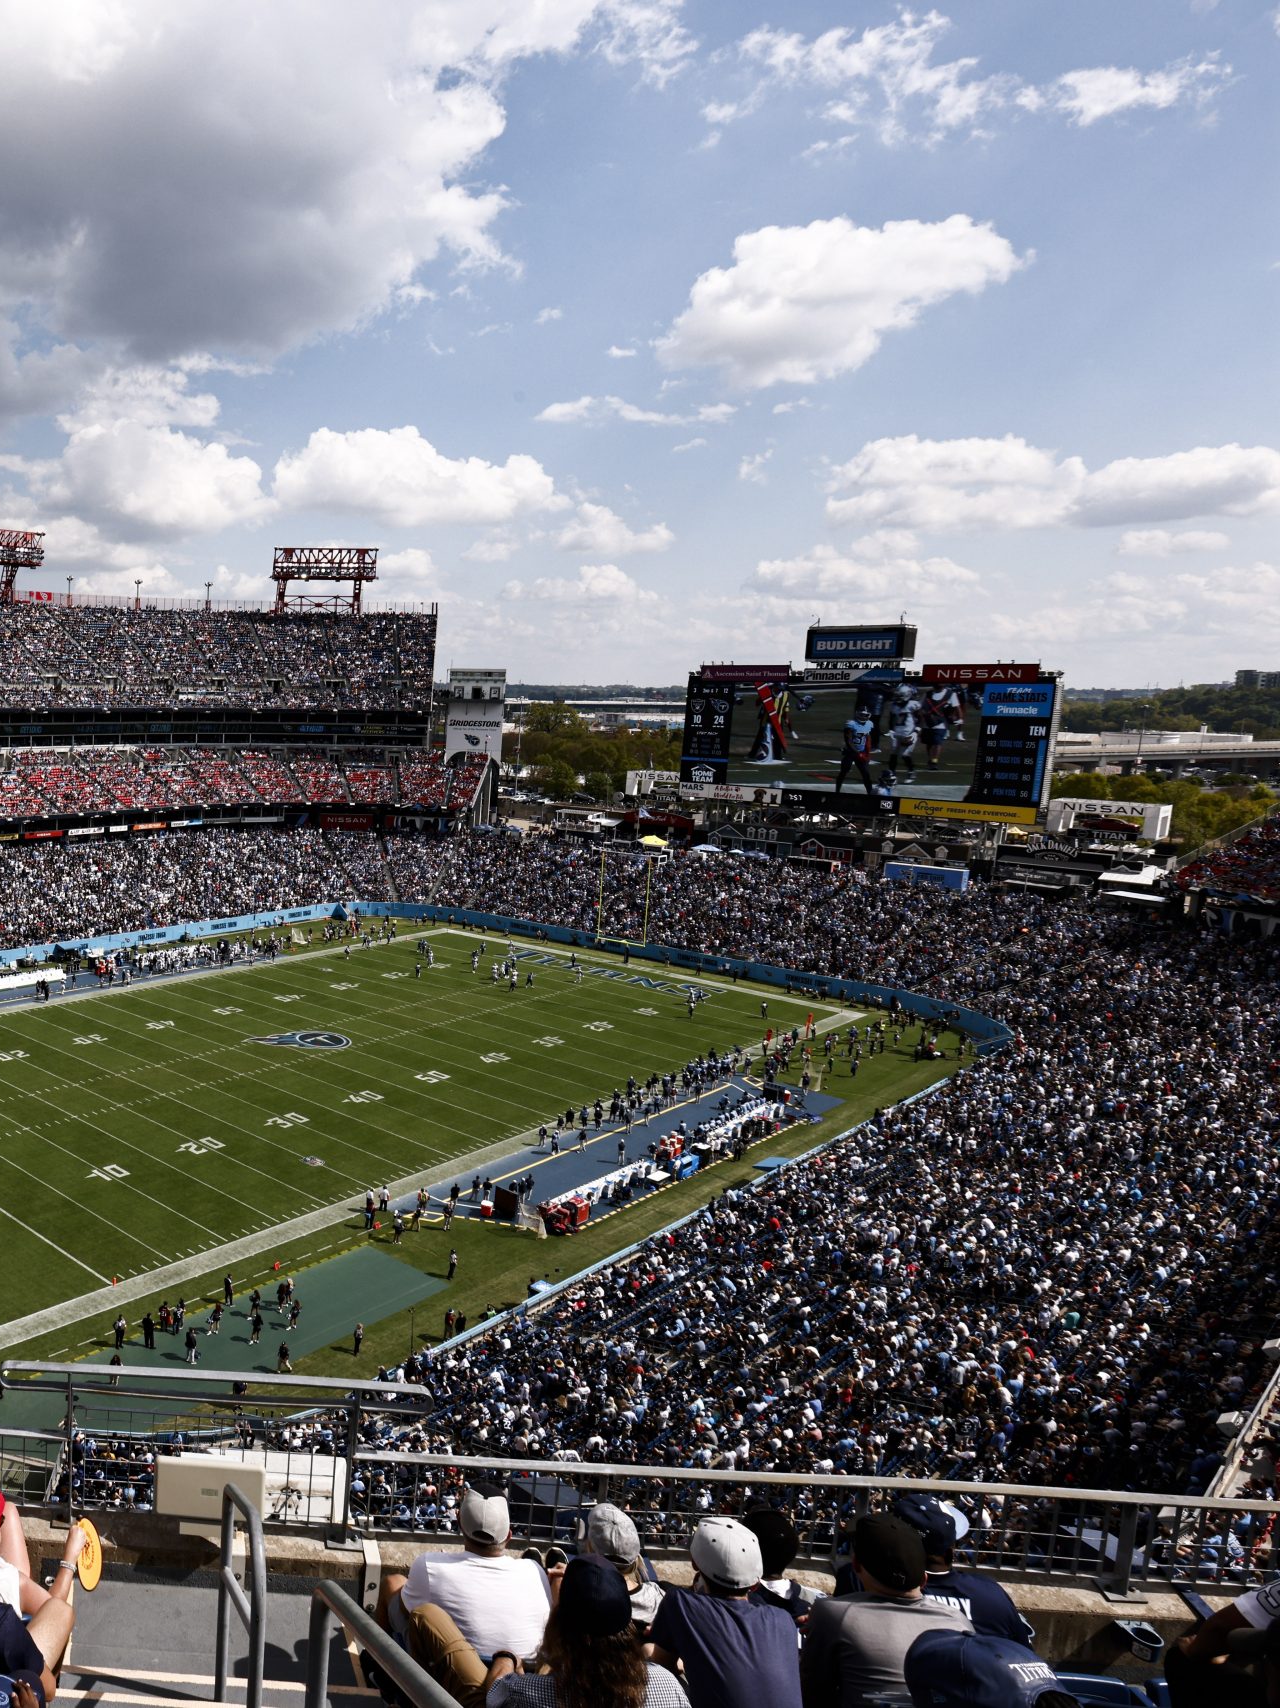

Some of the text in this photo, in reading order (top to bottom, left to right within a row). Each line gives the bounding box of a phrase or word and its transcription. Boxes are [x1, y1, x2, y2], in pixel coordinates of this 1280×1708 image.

[816, 639, 892, 651] BUD LIGHT
[805, 670, 851, 681] Pinnacle
[937, 669, 1022, 679] NISSAN
[988, 692, 1048, 703] GAME STATS
[996, 705, 1038, 715] Pinnacle
[448, 719, 501, 728] BRIDGESTONE
[693, 715, 724, 725] 10 24
[987, 724, 1046, 737] LV TEN
[635, 772, 680, 782] NISSAN
[1022, 774, 1031, 782] 80
[1020, 790, 1029, 798] 56
[881, 801, 893, 809] 40
[913, 801, 944, 815] Kroger
[1063, 802, 1145, 816] NISSAN
[327, 816, 368, 824] NISSAN
[1093, 831, 1128, 842] TITAN
[1026, 841, 1048, 854] JACK
[1048, 840, 1079, 858] DANIEL'S
[494, 949, 728, 1000] TITANS
[213, 1006, 244, 1016] 50
[151, 1020, 175, 1030] 40
[81, 1034, 108, 1045] 30
[0, 1049, 30, 1062] 20
[479, 1052, 506, 1063] 40
[415, 1070, 451, 1084] 50
[352, 1090, 385, 1104] 40
[273, 1111, 310, 1128] 30
[190, 1136, 227, 1155] 20
[98, 1163, 131, 1181] 10
